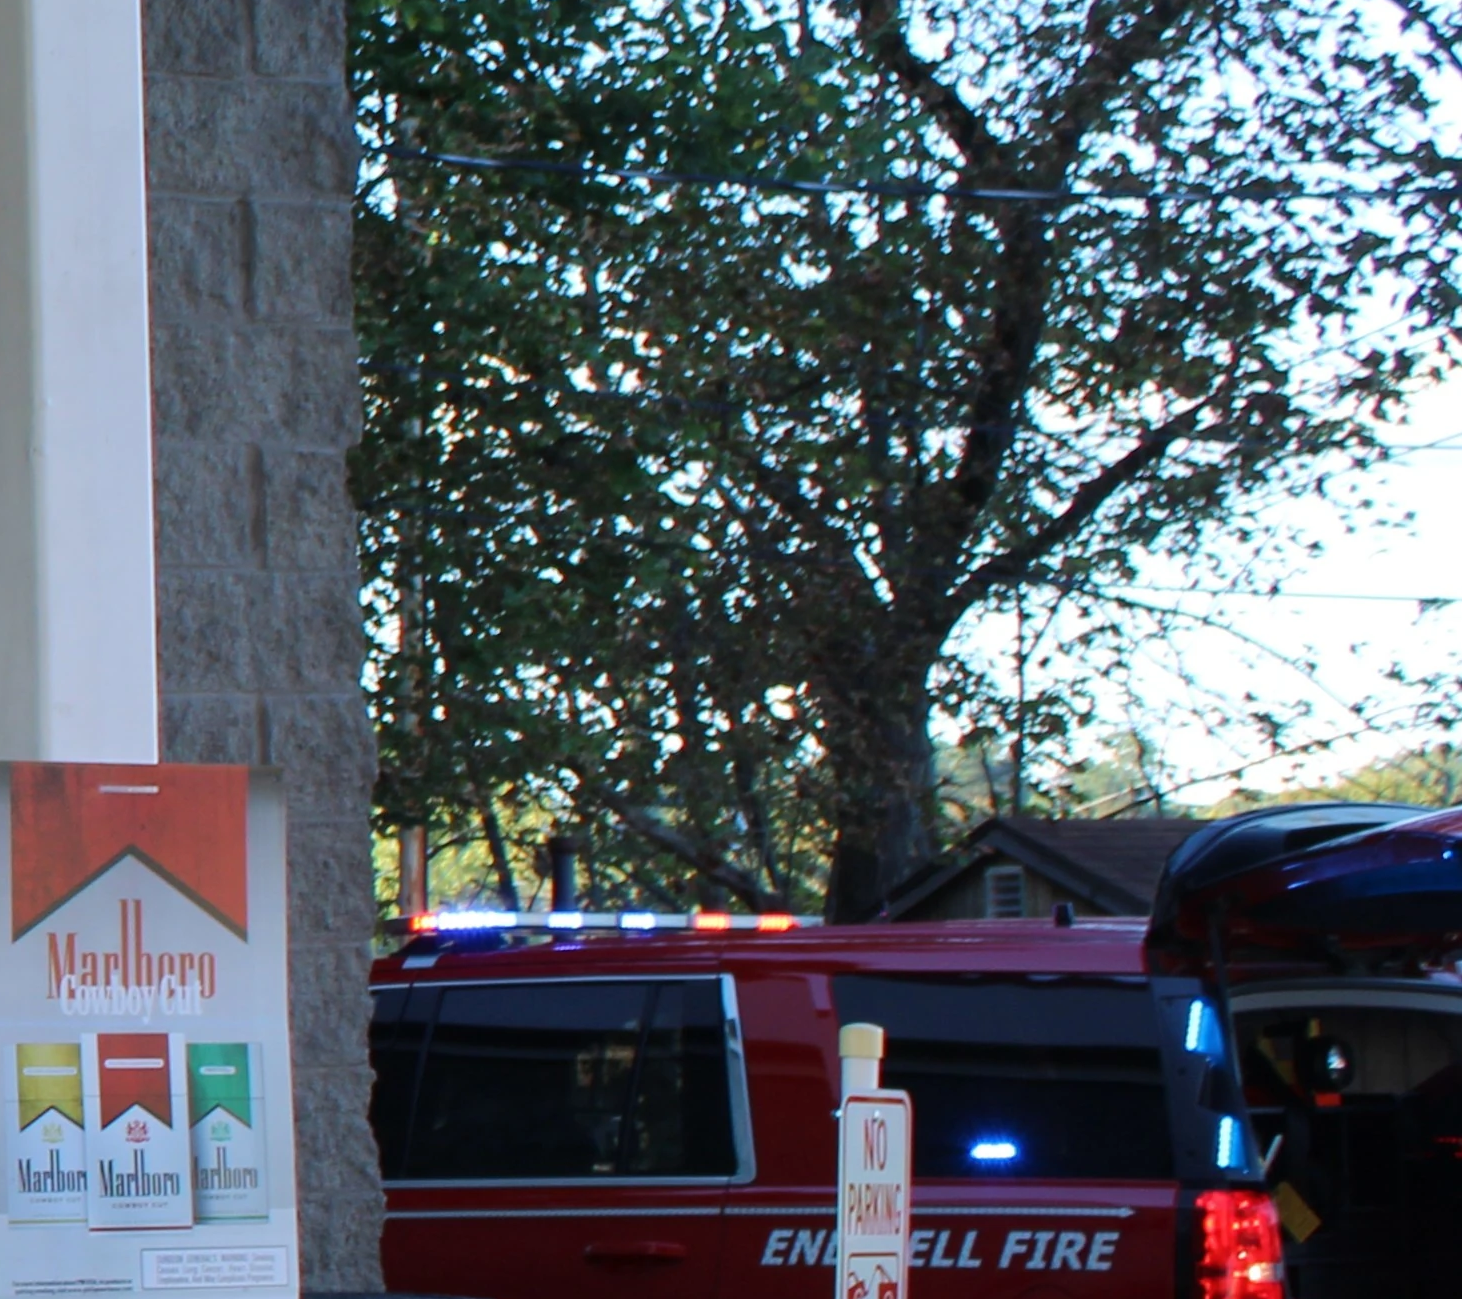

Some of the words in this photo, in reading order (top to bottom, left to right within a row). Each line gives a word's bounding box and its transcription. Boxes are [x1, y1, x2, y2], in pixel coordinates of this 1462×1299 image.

[45, 898, 216, 1000] Marlboro
[59, 974, 158, 1024] Cowboy
[159, 975, 205, 1017] Cut
[863, 1117, 888, 1171] NO
[98, 1149, 181, 1198] Marlboro
[847, 1182, 903, 1236] PARKING
[998, 1230, 1120, 1272] FIRE
